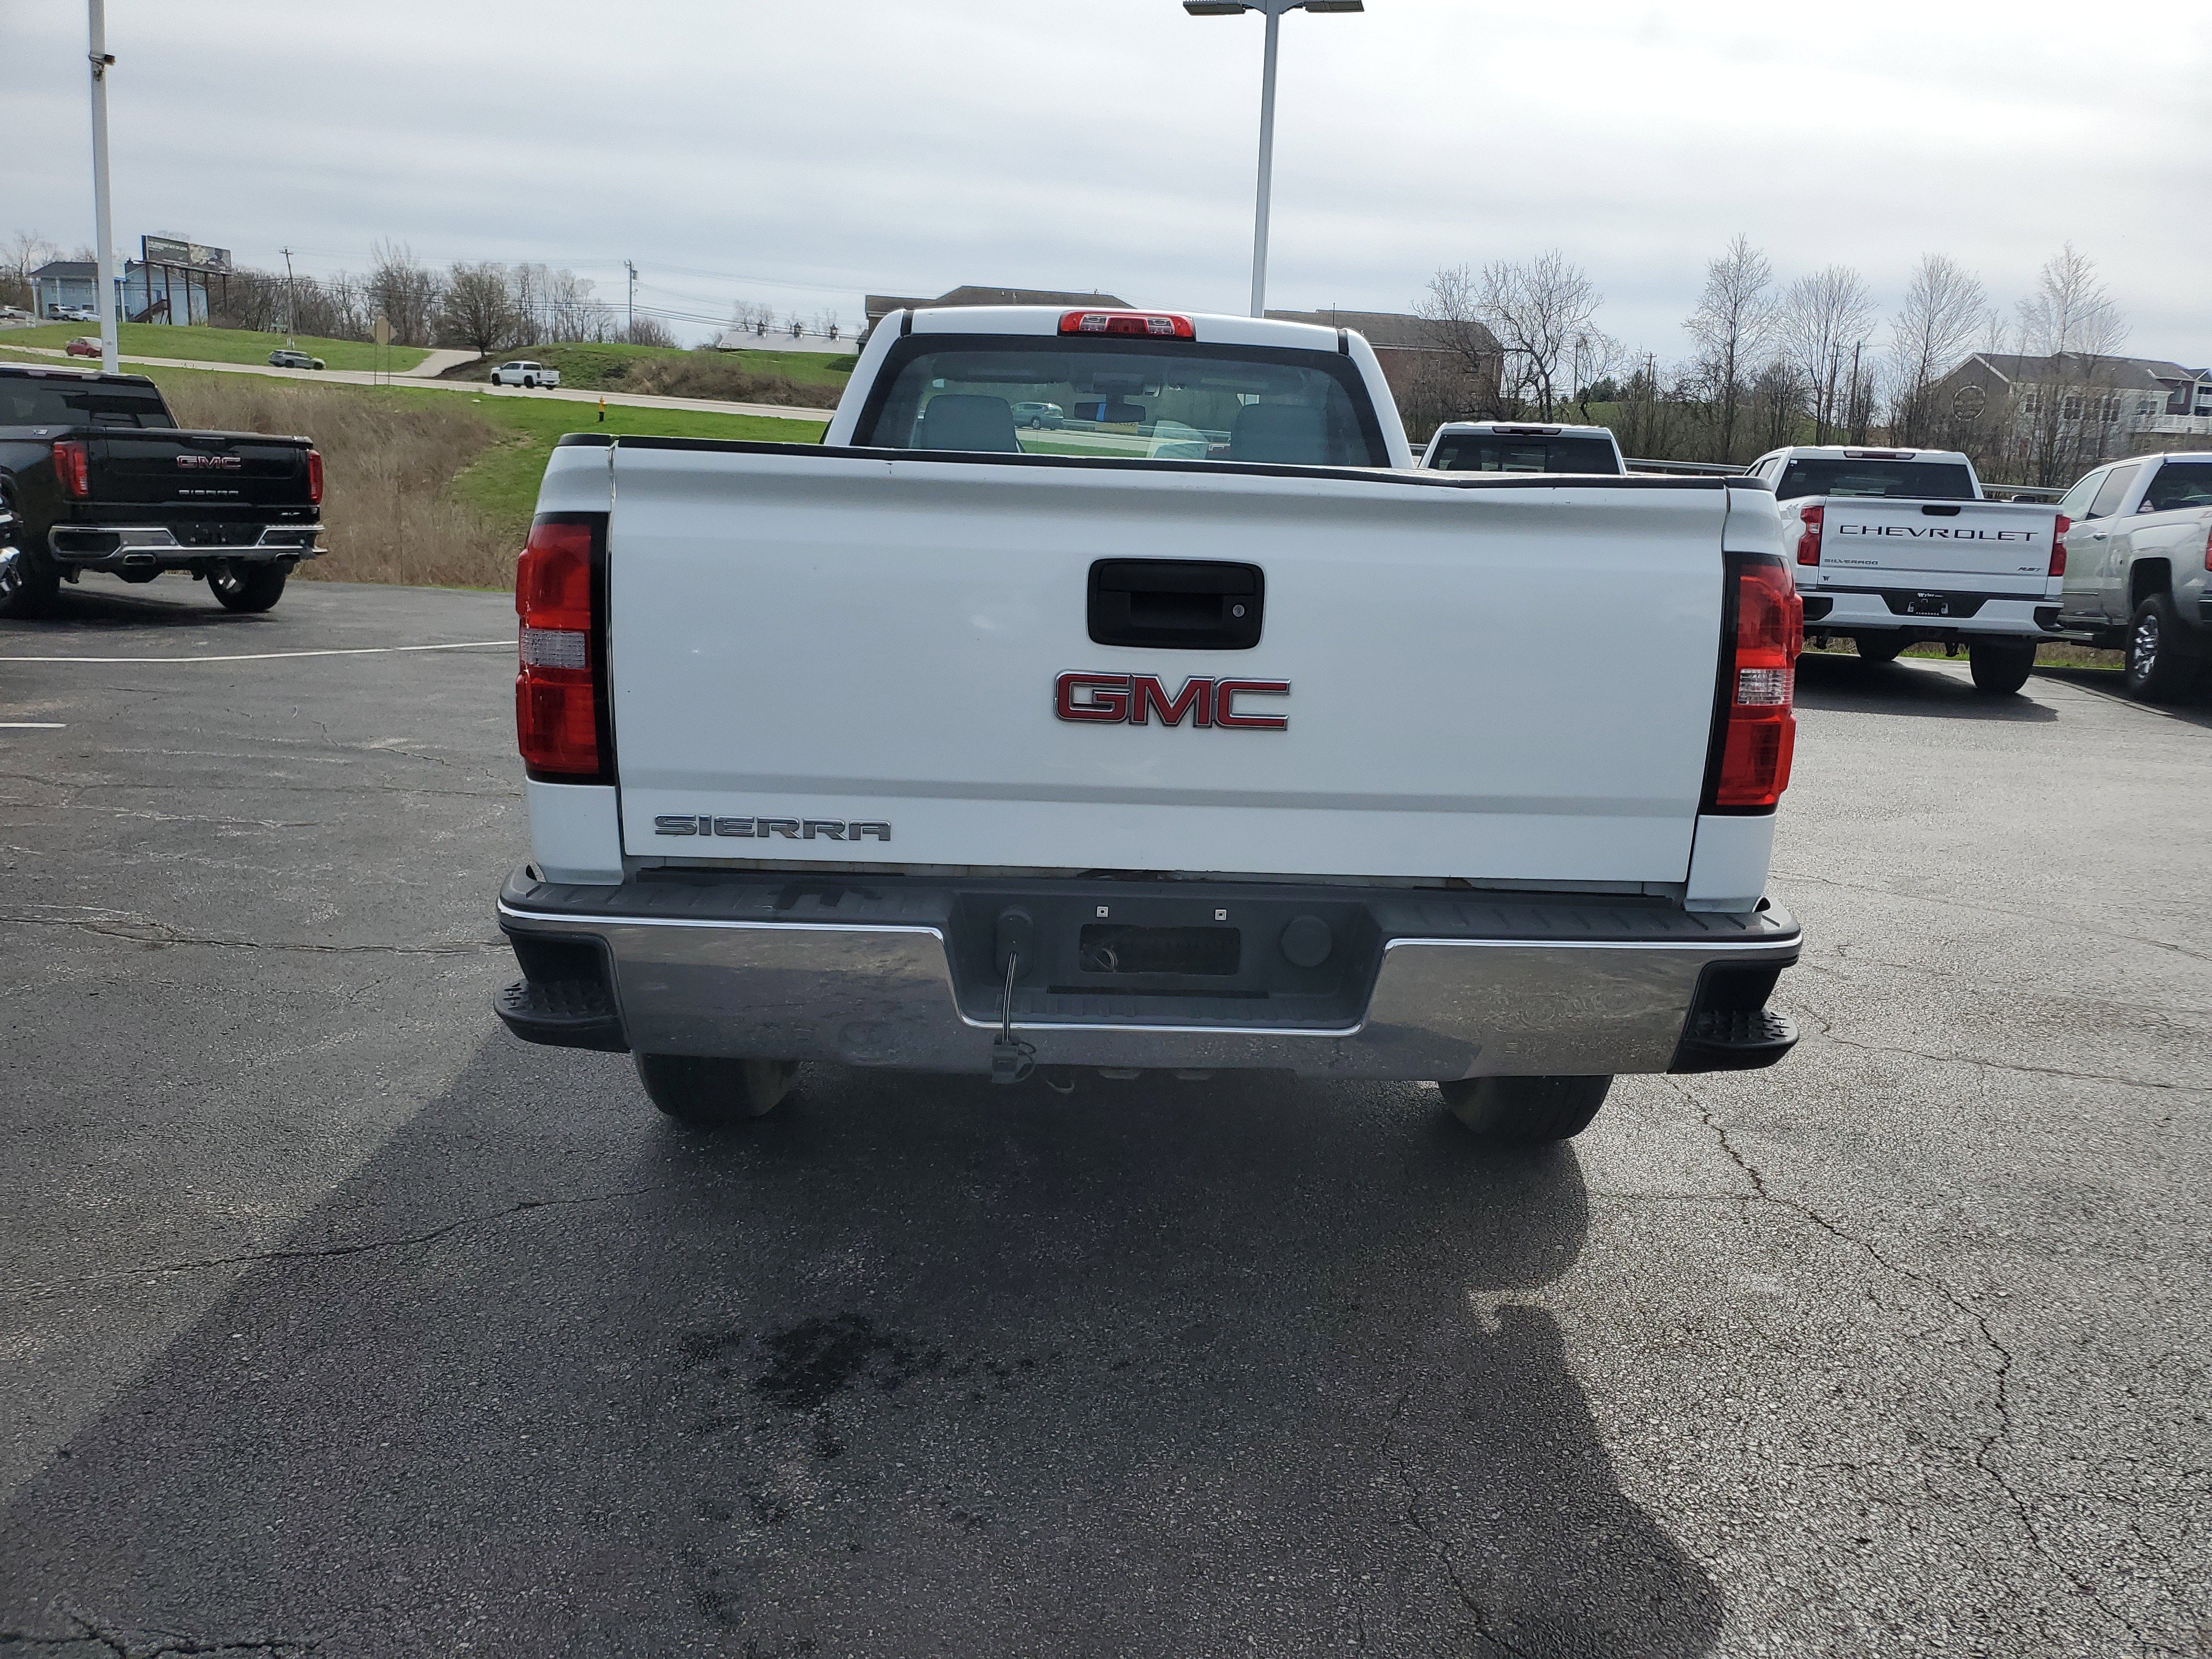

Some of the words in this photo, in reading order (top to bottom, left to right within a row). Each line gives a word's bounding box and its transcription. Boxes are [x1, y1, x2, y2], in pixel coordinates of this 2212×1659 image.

[177, 455, 241, 469] GMC
[1839, 525, 2039, 541] CHEVROLET
[1054, 669, 1291, 731] GMC
[654, 814, 891, 841] SIERRA
